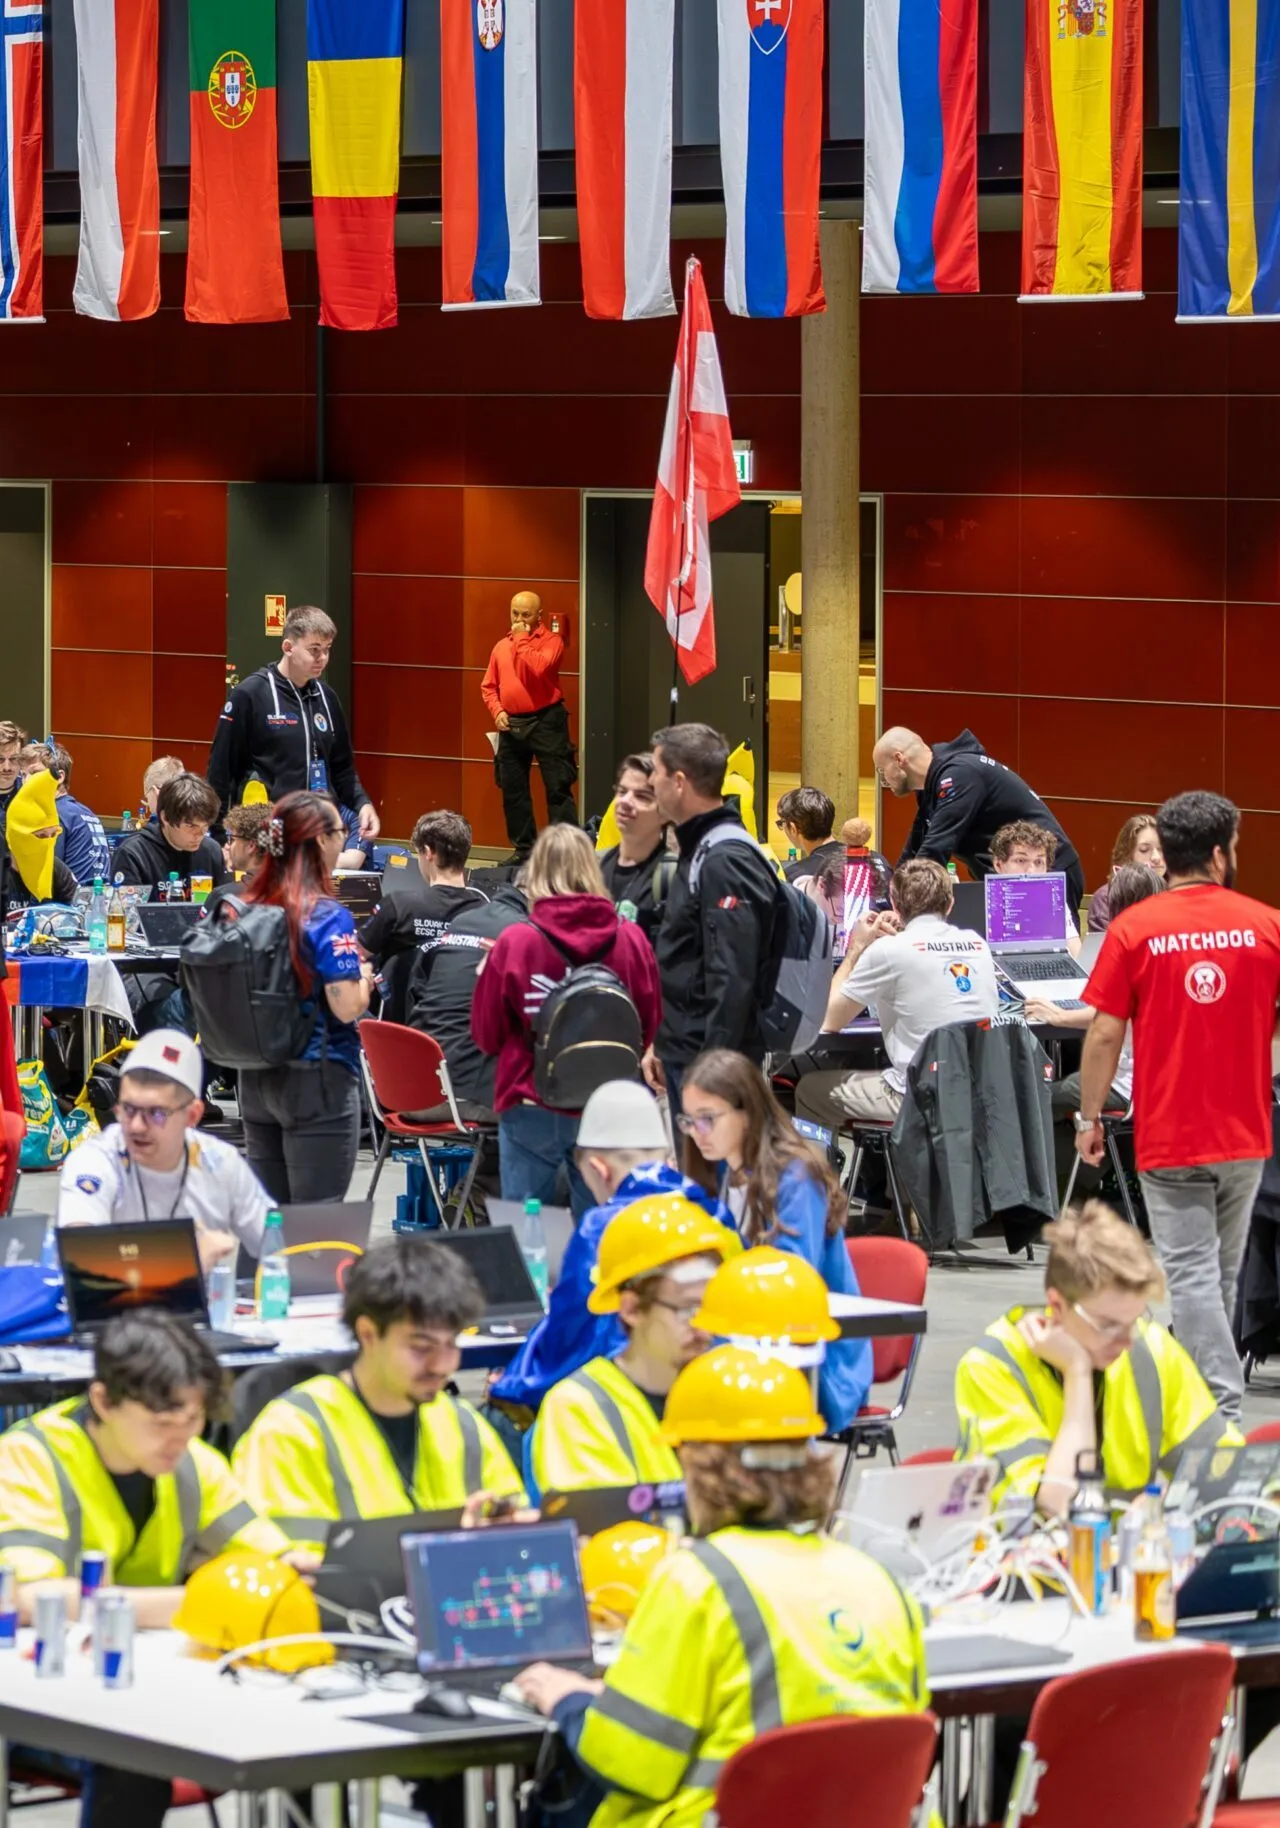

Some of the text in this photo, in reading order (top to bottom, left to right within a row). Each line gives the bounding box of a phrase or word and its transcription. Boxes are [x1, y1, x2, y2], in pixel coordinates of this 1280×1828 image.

[414, 918, 444, 930] SLOVAK
[415, 927, 436, 937] ECSC
[927, 941, 976, 953] AUSTRIA
[1148, 929, 1257, 957] WATCHDOG
